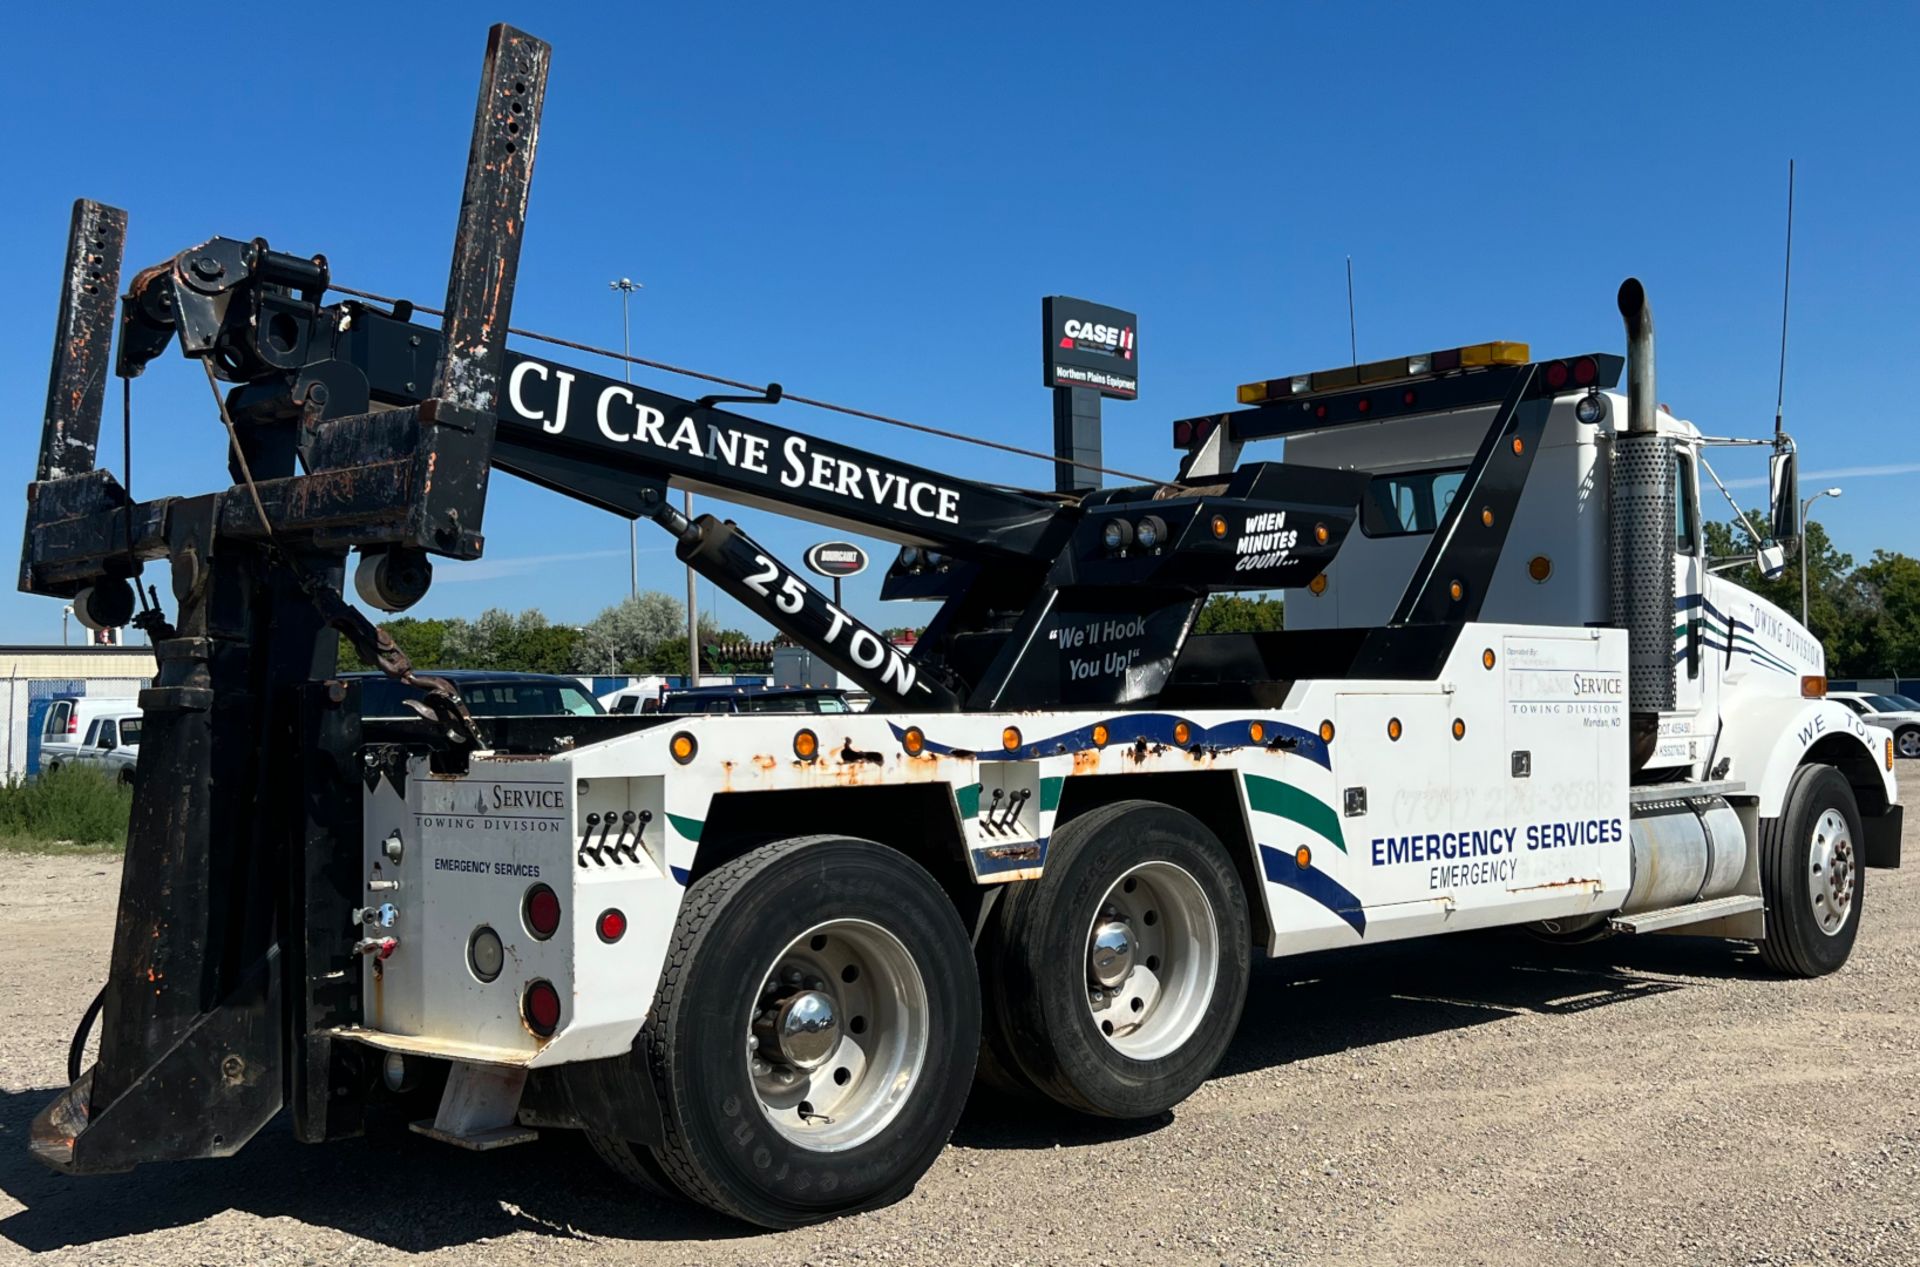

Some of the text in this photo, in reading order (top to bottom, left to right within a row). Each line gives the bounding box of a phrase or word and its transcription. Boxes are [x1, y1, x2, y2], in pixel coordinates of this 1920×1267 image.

[1064, 319, 1118, 346] CASE
[1056, 366, 1136, 390] Northern Plains Equipment
[508, 361, 960, 524] CJ CRANE SERVICE
[1245, 510, 1286, 534] WHEN
[1236, 529, 1298, 555] MINUTES
[1235, 549, 1299, 572] COUNT...
[742, 554, 916, 697] 25 TON
[1102, 615, 1146, 642] Hook
[1749, 603, 1821, 669] TOWING DIVISION
[1069, 658, 1100, 681] You
[1573, 673, 1622, 696] SERVICE
[1512, 704, 1619, 714] TOWING DIVISION
[1797, 712, 1877, 750] WE TOW
[493, 784, 564, 810] SERVICE
[415, 817, 560, 832] TOWING DIVISION
[1371, 818, 1622, 866] EMERGENCY SERVICES
[434, 858, 540, 878] EMERGENCY SERVICES
[1429, 857, 1518, 890] EMERGENCY
